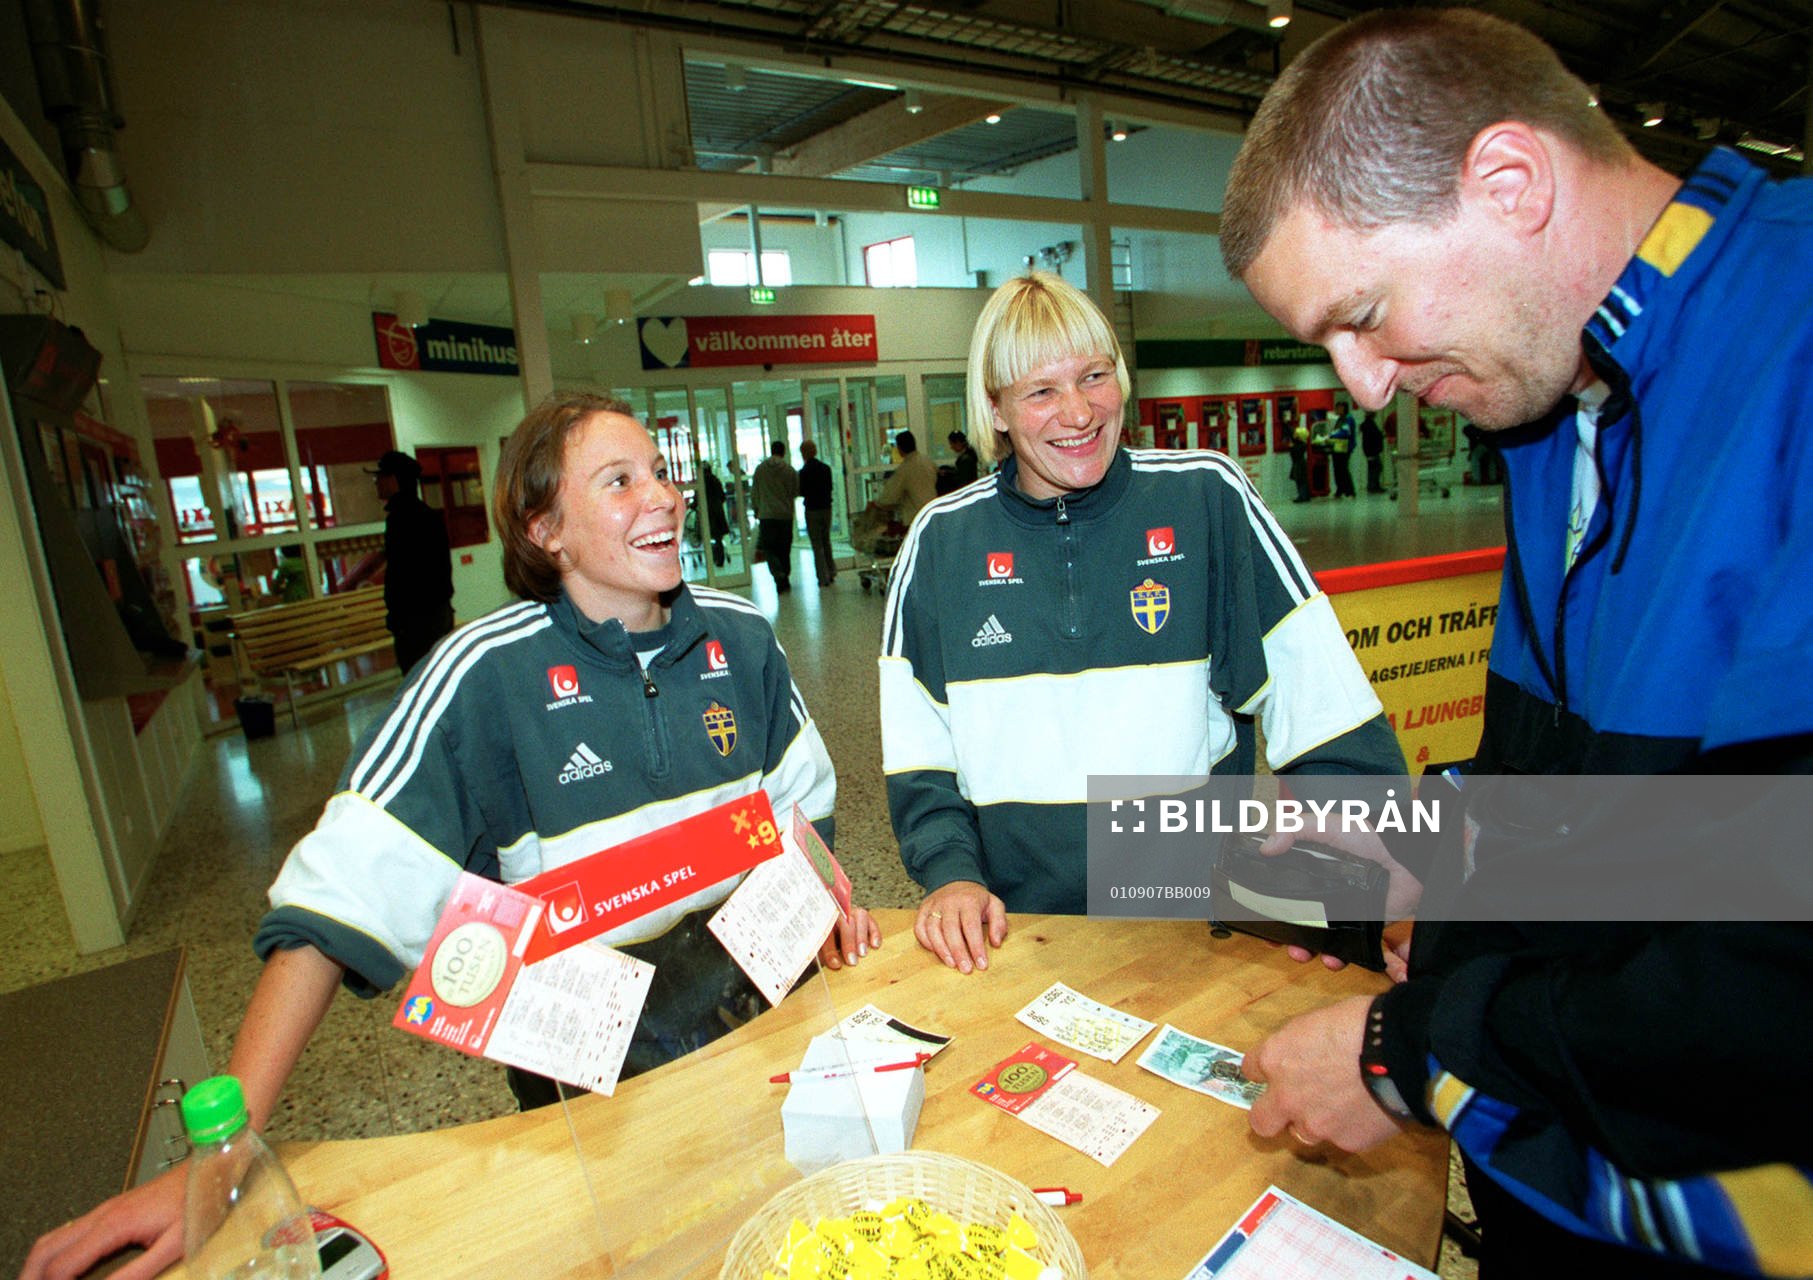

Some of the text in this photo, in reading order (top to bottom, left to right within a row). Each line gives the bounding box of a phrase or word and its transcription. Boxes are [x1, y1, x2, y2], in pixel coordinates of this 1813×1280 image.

[426, 334, 517, 365] minihus
[695, 327, 873, 351] välkommen åter
[1136, 553, 1185, 567] SVENSKA SPEL
[978, 579, 1007, 587] SVENSKA
[972, 631, 1012, 648] adidas
[1387, 615, 1432, 644] OCH
[700, 670, 729, 680] SVENSKA
[1365, 651, 1465, 685] AGSTJEJERNA
[1469, 652, 1476, 666] I
[546, 694, 594, 711] SVENSKA SPEL
[558, 759, 614, 785] adidas
[593, 864, 697, 917] SVENSKA SPEL
[1004, 1066, 1029, 1086] 100
[1012, 1069, 1041, 1091] TUSEN
